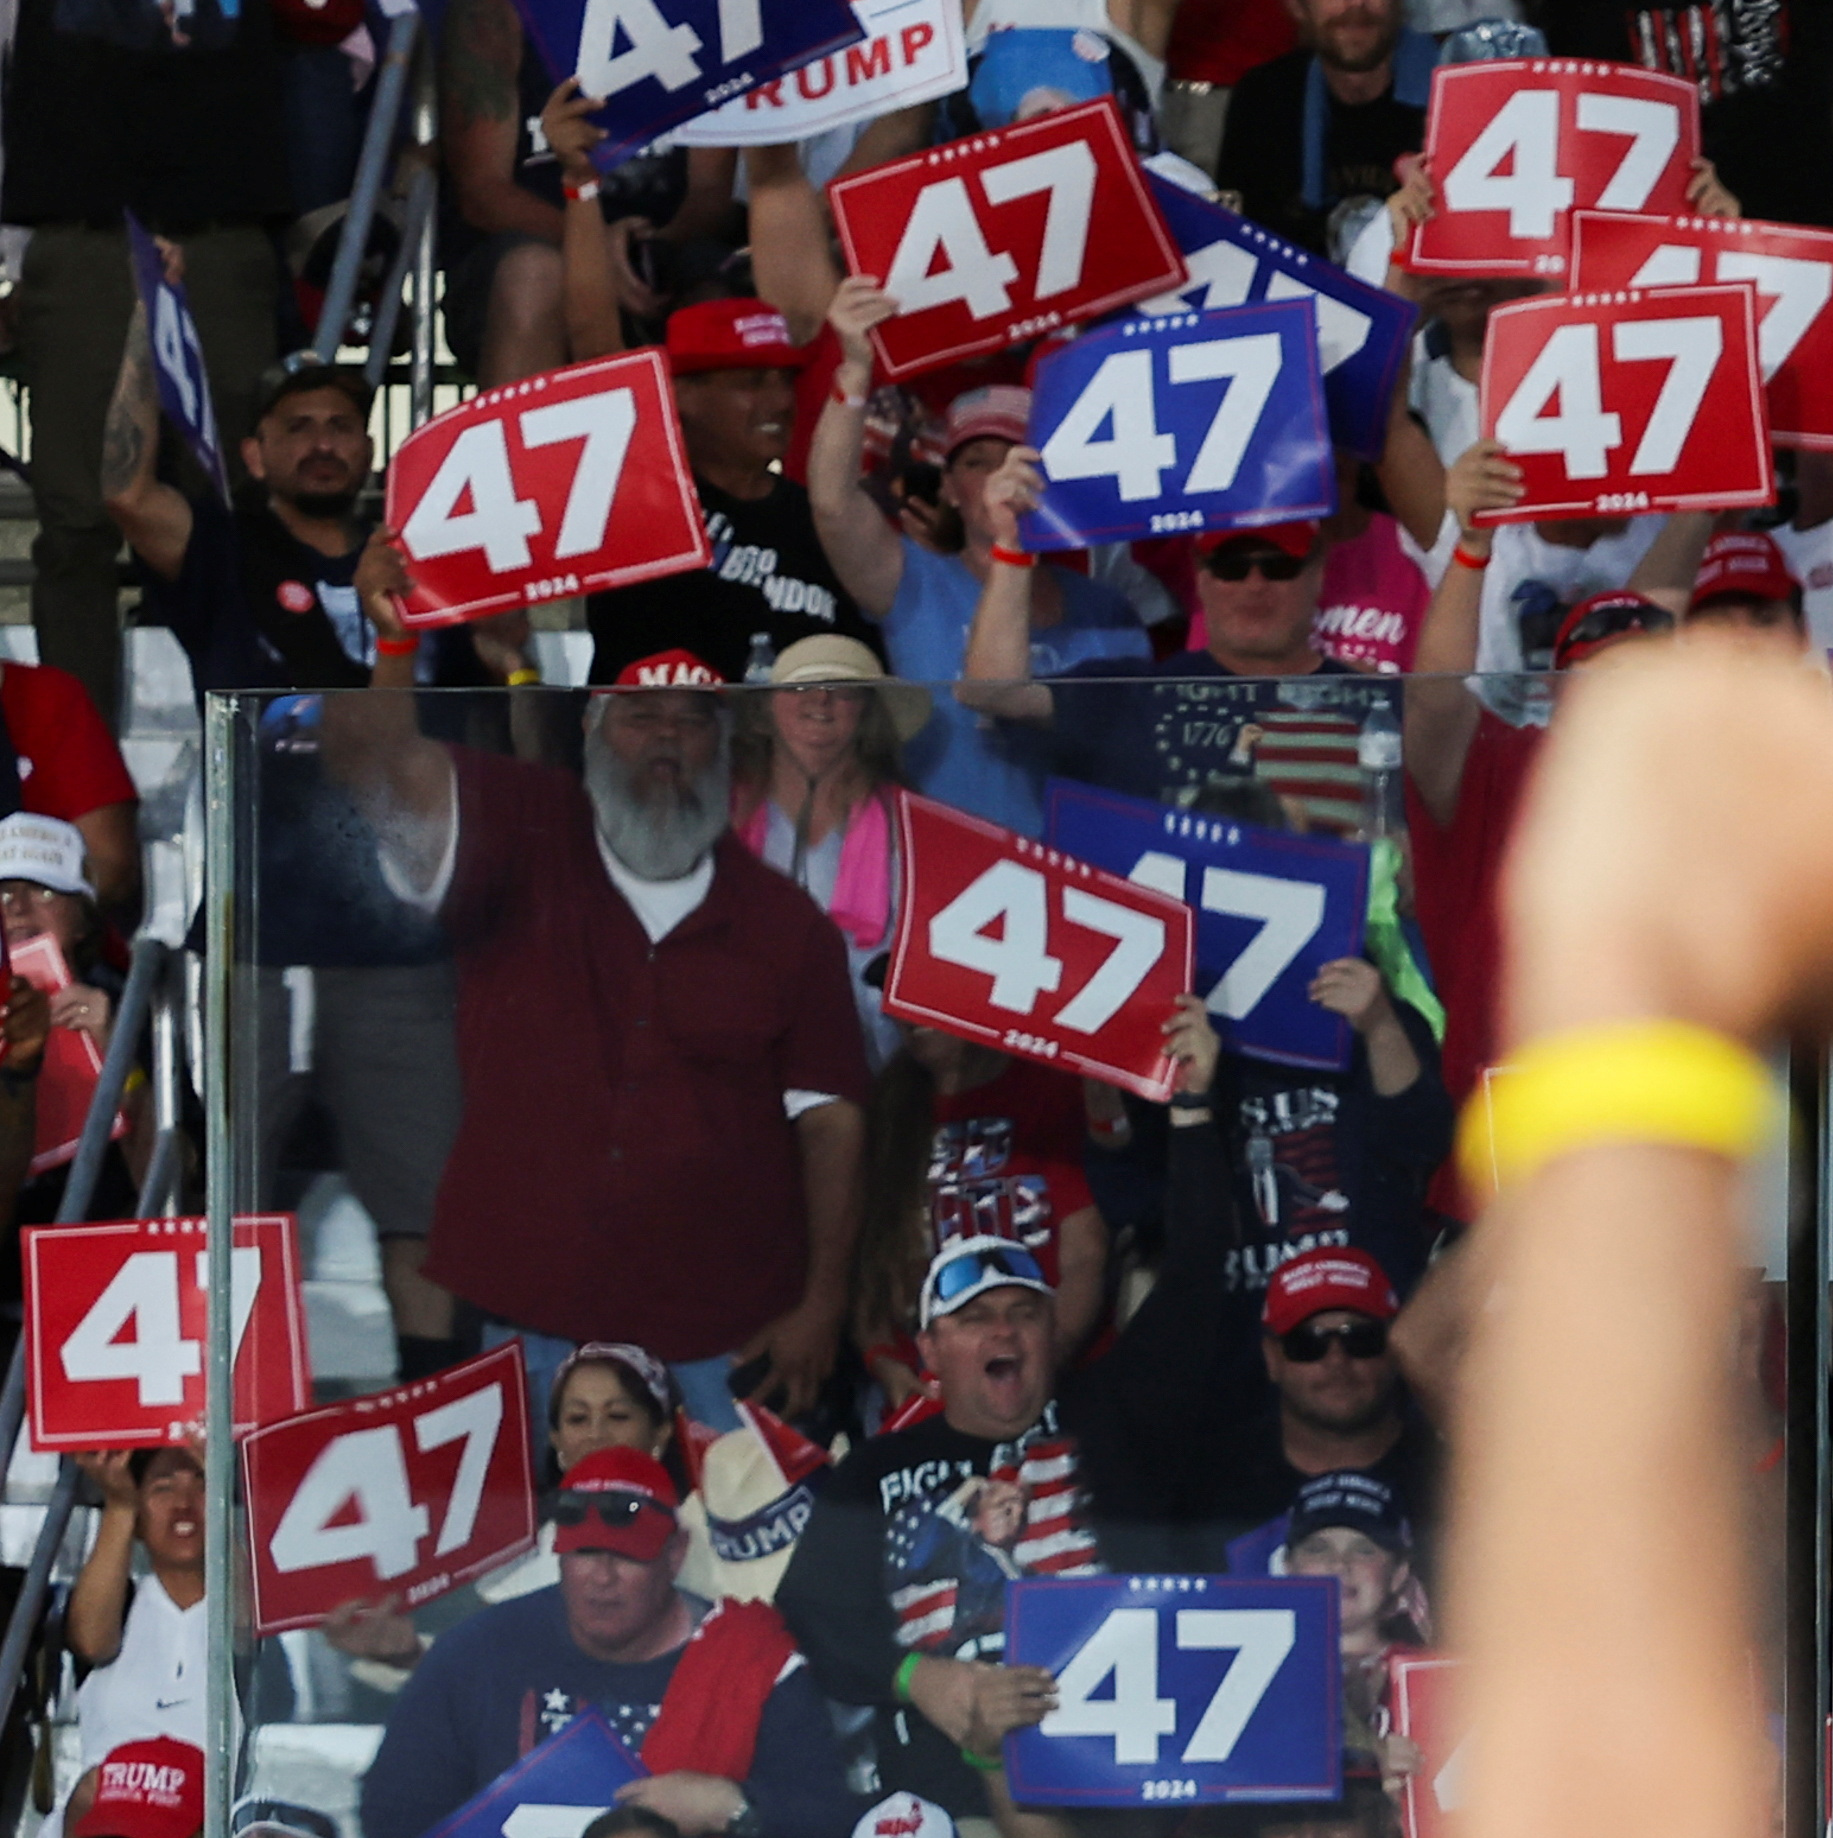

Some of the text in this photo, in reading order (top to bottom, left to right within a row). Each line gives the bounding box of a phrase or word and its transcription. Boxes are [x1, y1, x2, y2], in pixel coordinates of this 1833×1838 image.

[705, 72, 756, 104] 2024
[742, 21, 934, 111] RUMP
[1445, 89, 1681, 240] 47
[884, 141, 1097, 321] 47
[1536, 255, 1565, 273] 20
[1042, 333, 1283, 502] 47
[1495, 317, 1723, 481] 47
[401, 388, 639, 574] 47
[1596, 491, 1651, 513] 2024
[1150, 511, 1205, 535] 2024
[525, 573, 580, 603] 2024
[1313, 604, 1406, 644] men
[638, 662, 724, 688] MAG
[929, 859, 1166, 1035] 47
[1130, 851, 1326, 1021] 7
[1004, 1028, 1060, 1060] 2024
[270, 1382, 503, 1578] 47
[716, 1503, 813, 1560] RUMP
[1040, 1609, 1297, 1766] 47
[102, 1762, 186, 1792] TRUMP
[1143, 1779, 1197, 1801] 2024
